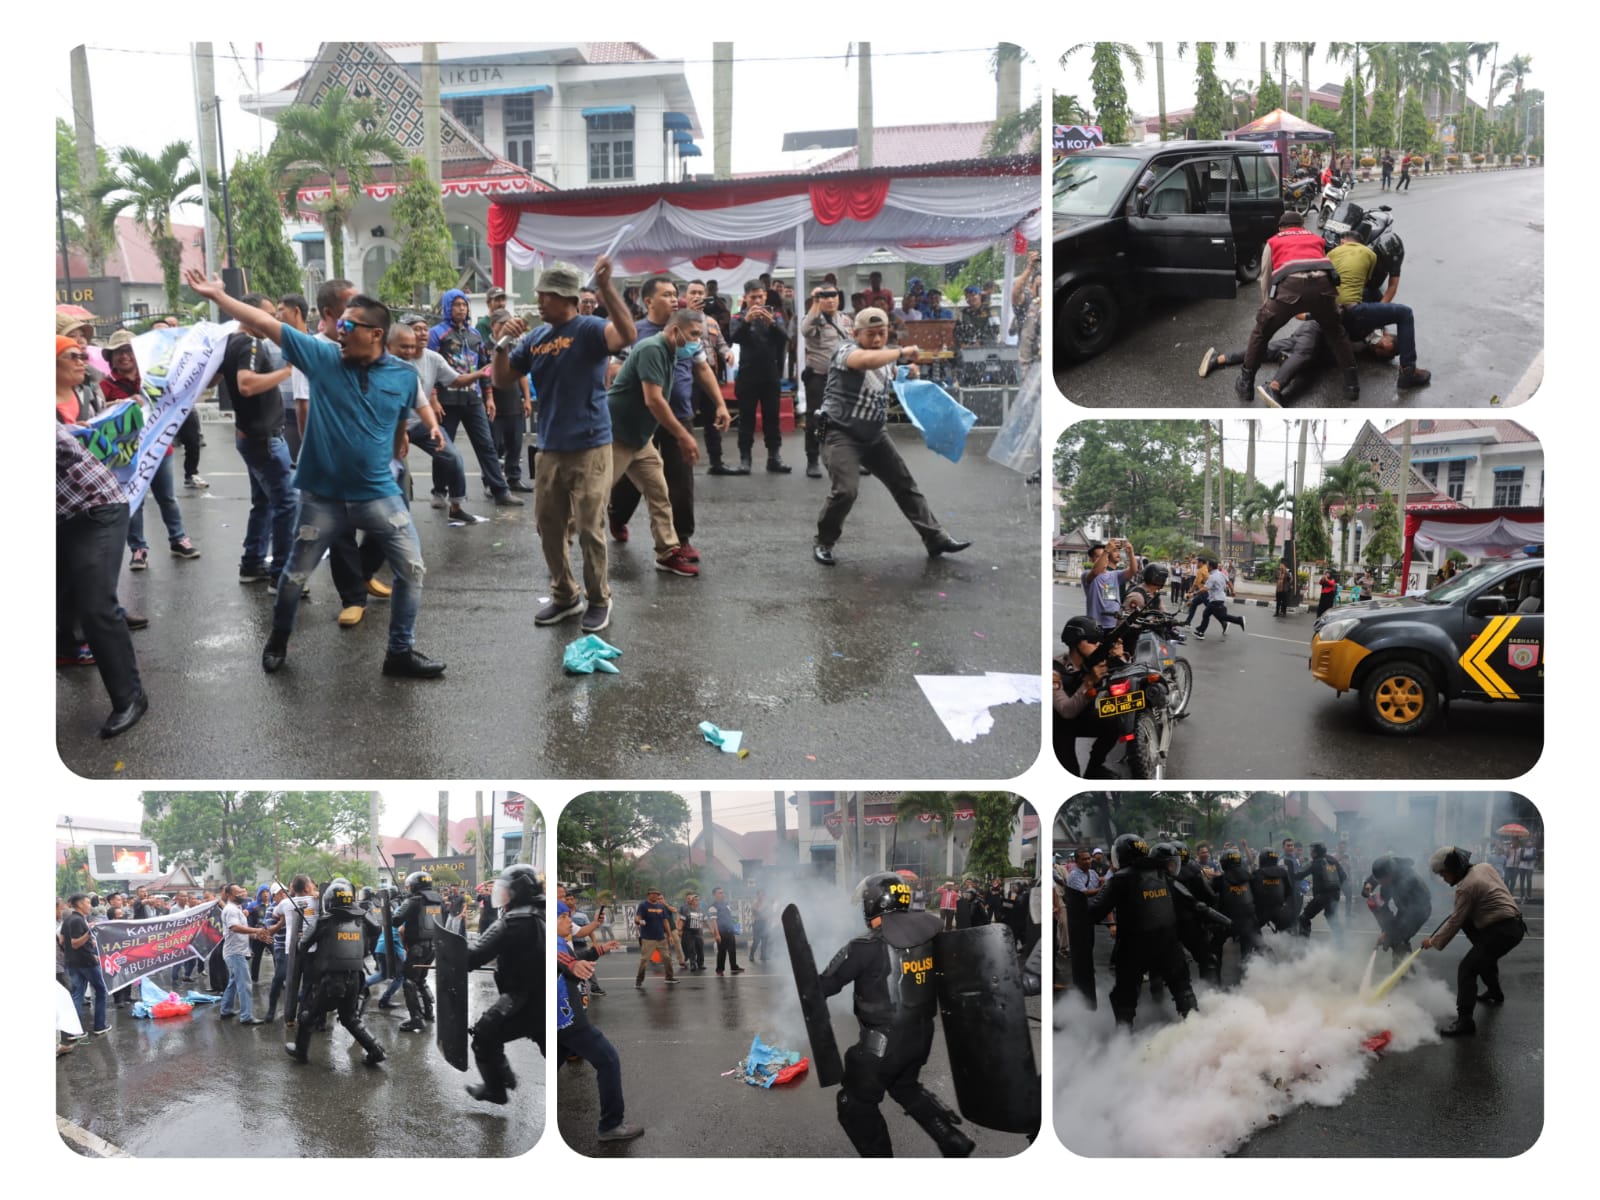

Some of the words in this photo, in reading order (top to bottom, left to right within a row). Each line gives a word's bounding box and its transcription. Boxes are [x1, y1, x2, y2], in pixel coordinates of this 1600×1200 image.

[1066, 139, 1096, 150] KOTA
[421, 862, 465, 871] KANTOR
[1143, 888, 1167, 899] POLISI
[127, 923, 162, 937] KAMI
[102, 938, 145, 952] HASIL
[903, 957, 933, 974] POLISI
[915, 972, 926, 984] 97
